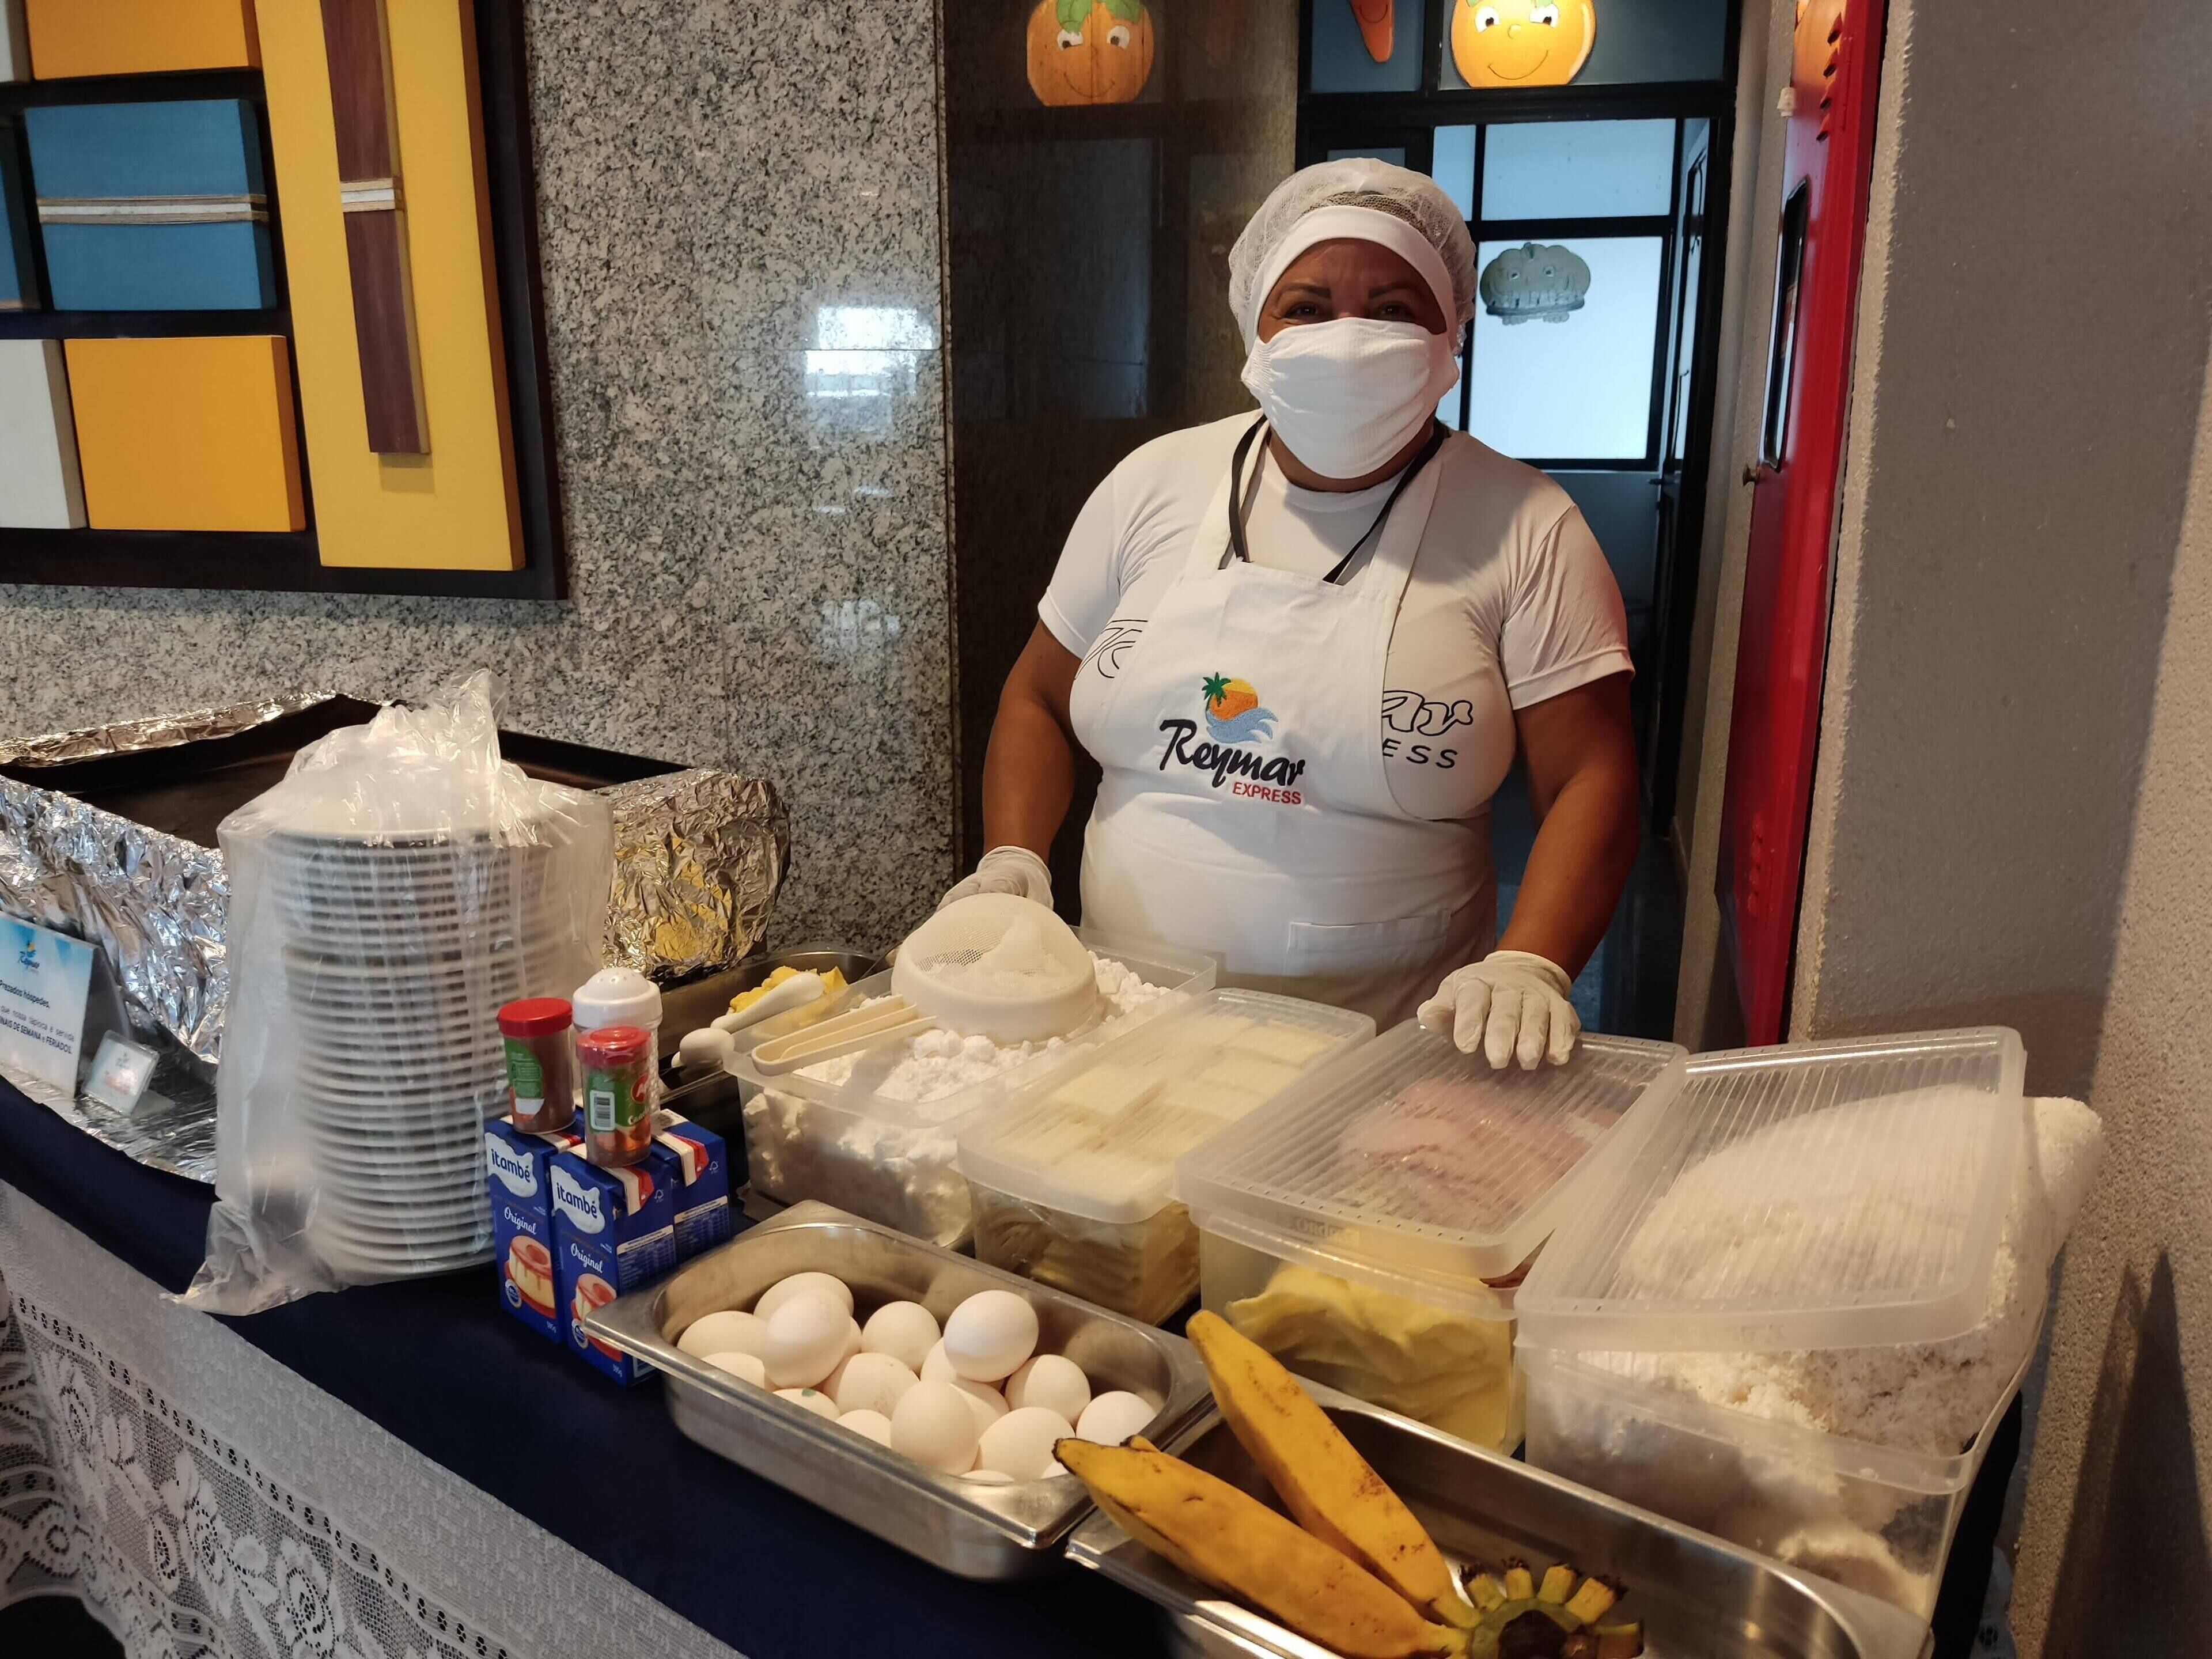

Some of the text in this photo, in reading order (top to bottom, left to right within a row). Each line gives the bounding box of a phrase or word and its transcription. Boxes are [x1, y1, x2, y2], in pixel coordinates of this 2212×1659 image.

[1160, 719, 1305, 788] Reymar
[1232, 782, 1302, 804] EXPRESS
[491, 1149, 531, 1183] itambé
[556, 1182, 597, 1219] itambé
[504, 1206, 537, 1235] Original
[570, 1243, 603, 1274] Original
